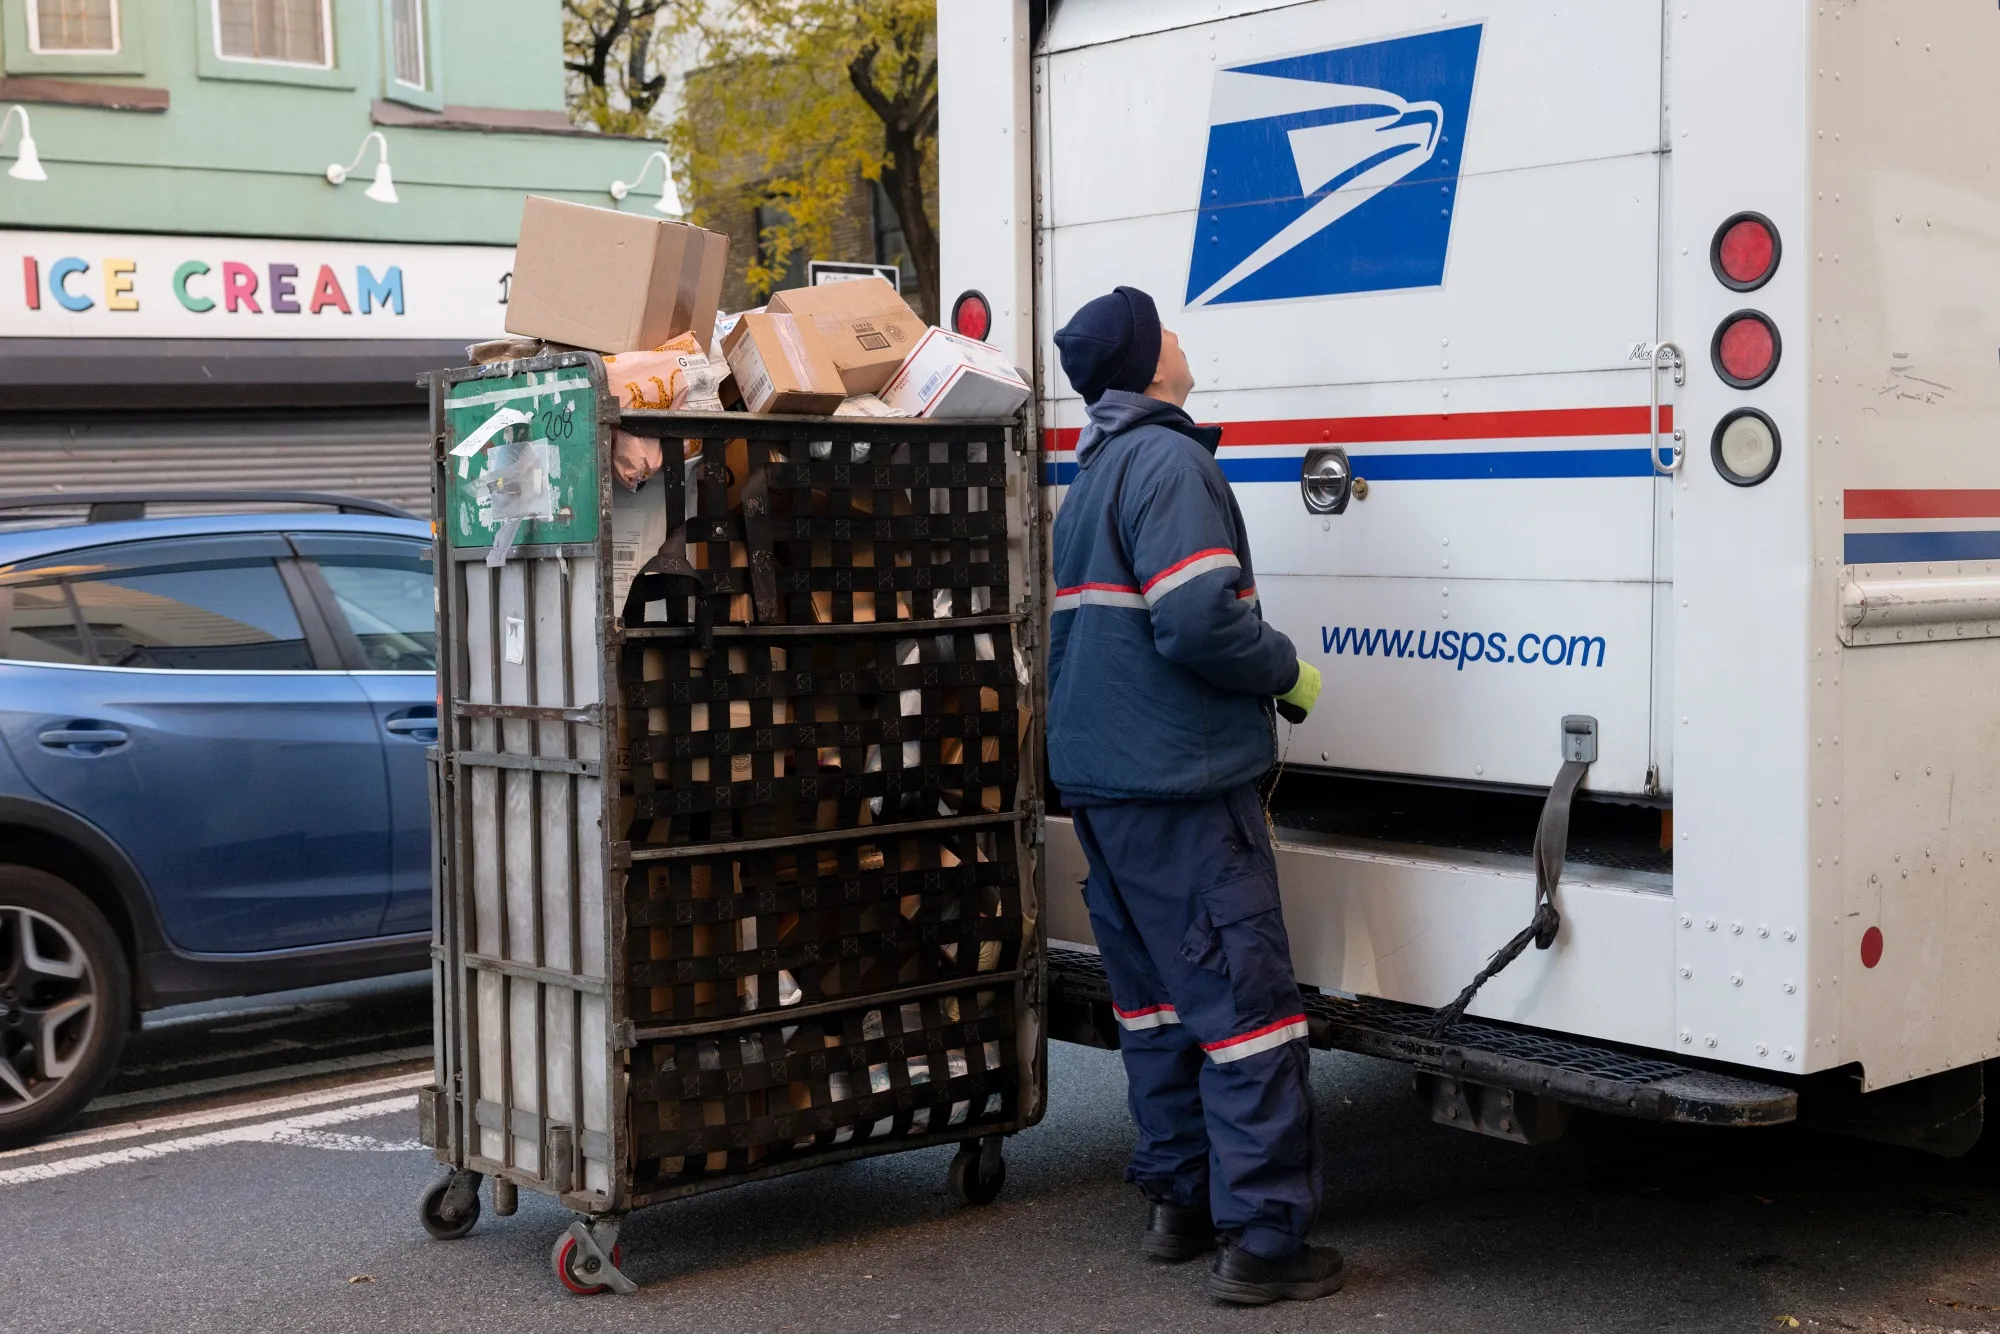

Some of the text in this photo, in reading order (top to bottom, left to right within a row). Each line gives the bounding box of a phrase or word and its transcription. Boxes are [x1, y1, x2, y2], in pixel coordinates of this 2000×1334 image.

[23, 256, 405, 315] ICE CREAM
[678, 357, 688, 367] G
[893, 369, 911, 392] PRIORITY
[542, 407, 573, 441] 208
[1321, 626, 1606, 671] www.usps.com
